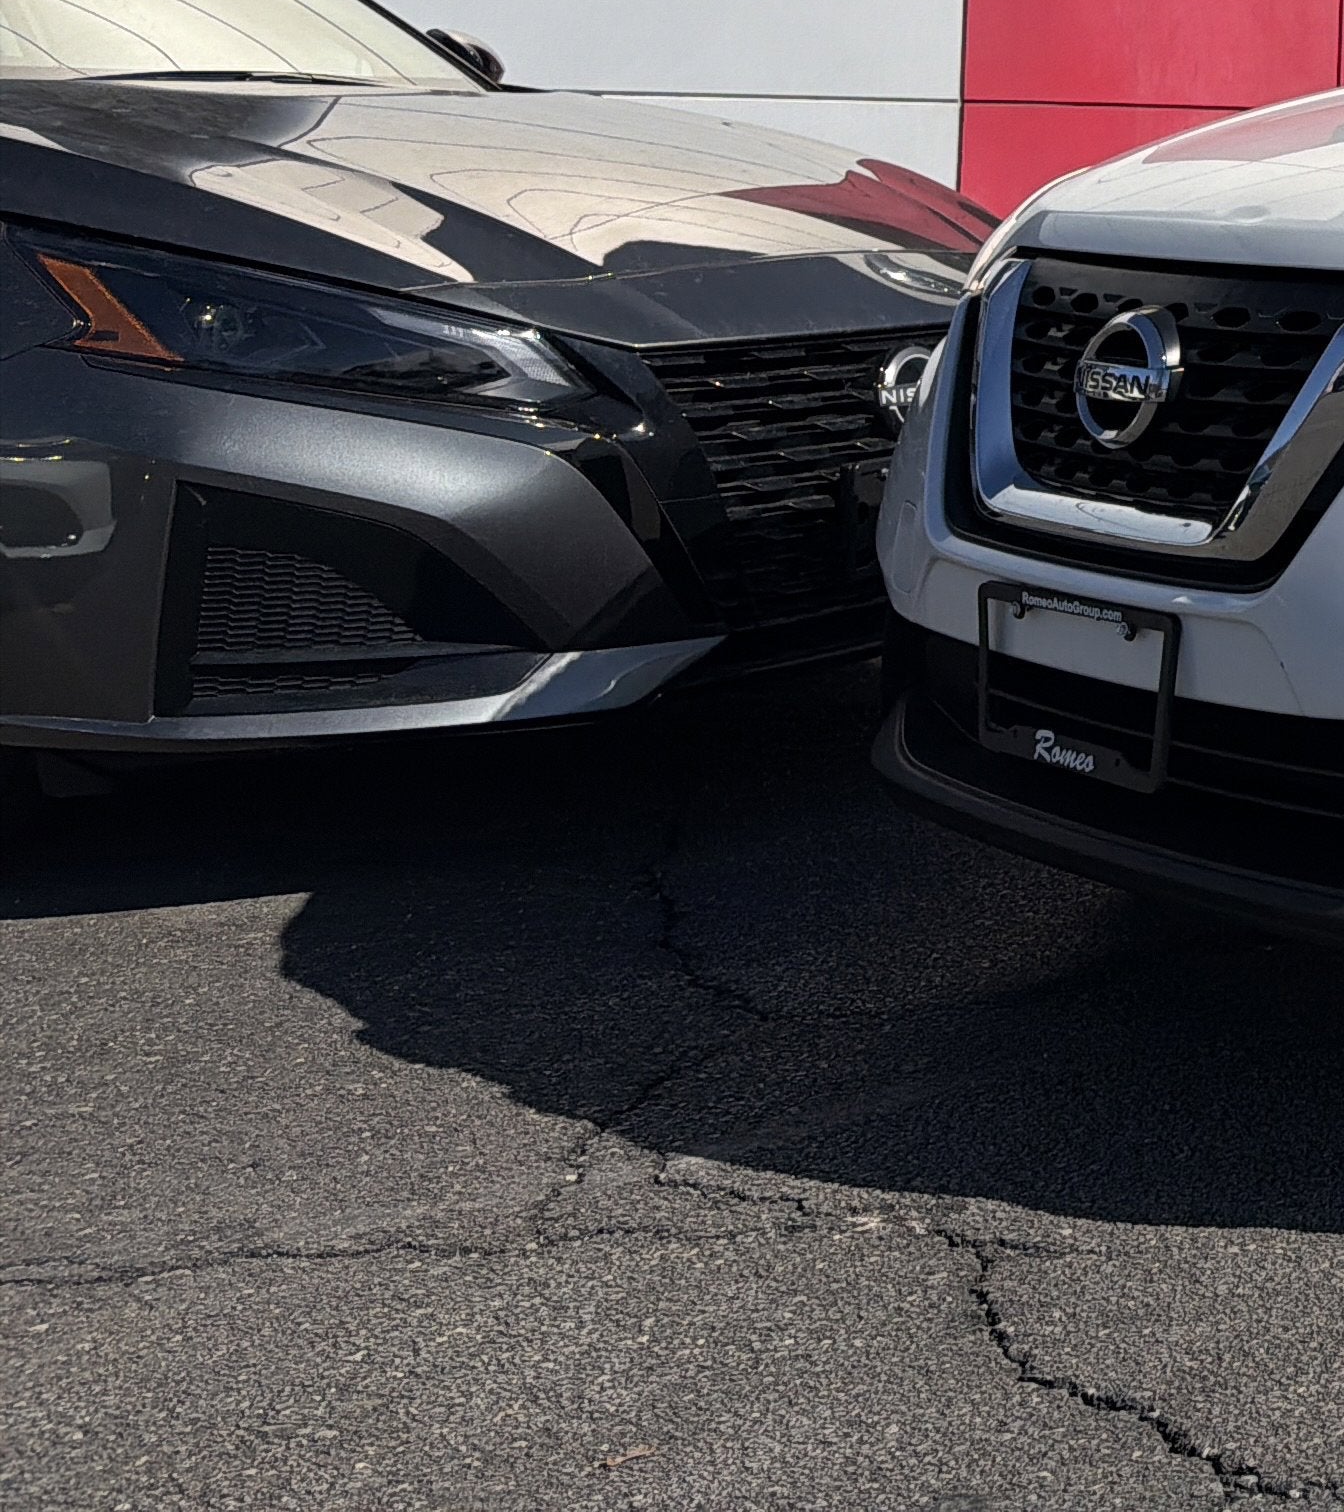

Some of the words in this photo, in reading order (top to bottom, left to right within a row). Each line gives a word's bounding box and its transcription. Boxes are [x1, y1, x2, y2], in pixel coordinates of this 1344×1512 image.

[881, 387, 917, 405] NIS
[1077, 364, 1151, 396] NISSAN
[1021, 590, 1123, 622] RomeoAutoGroup.com
[1033, 728, 1095, 773] Romeo
